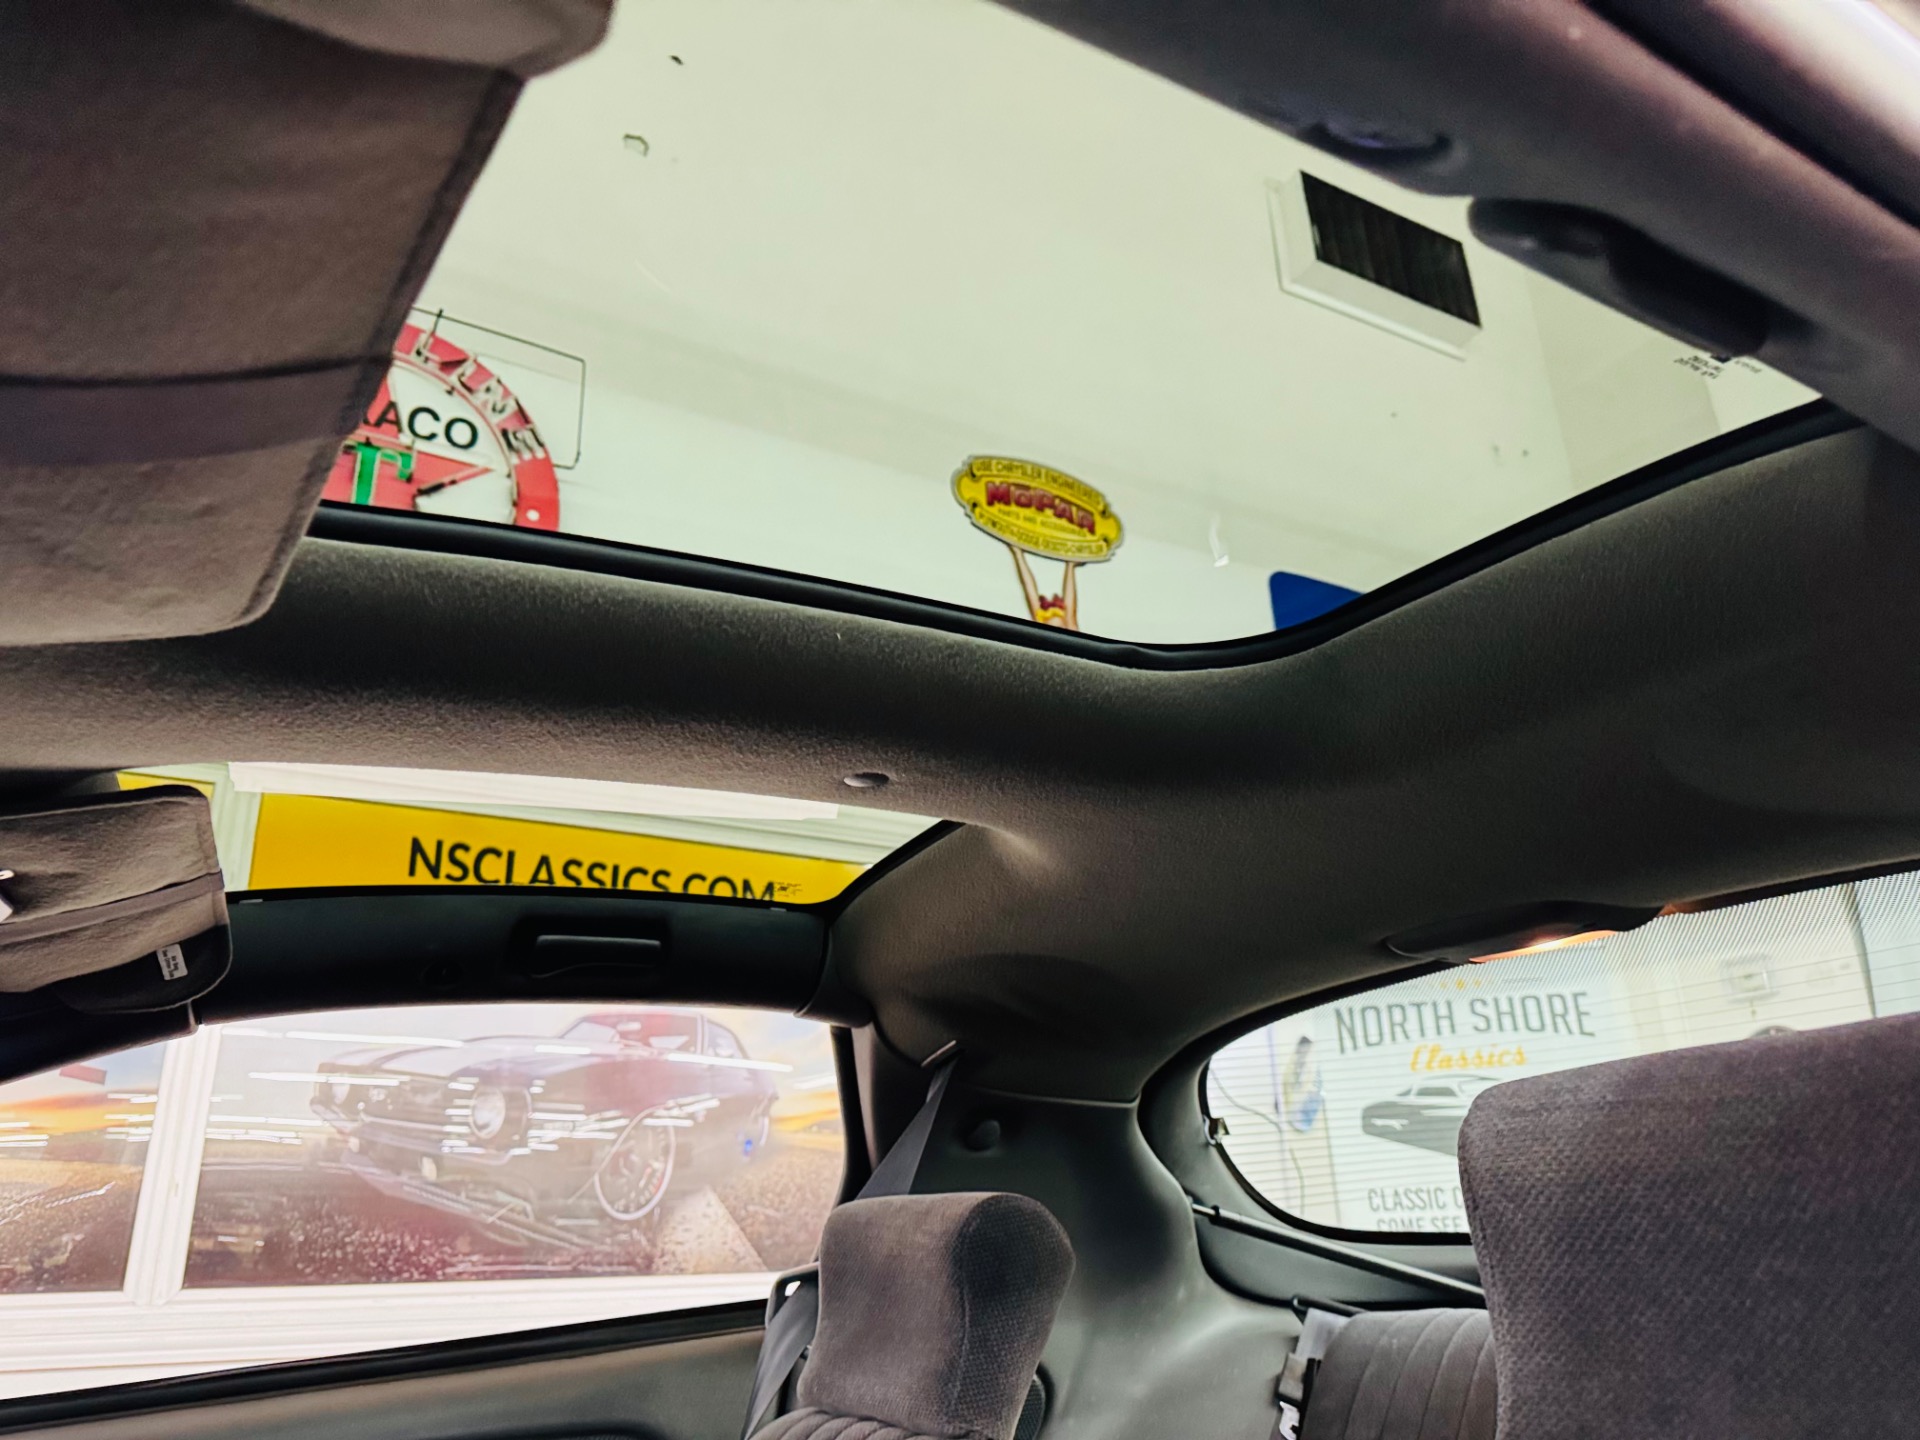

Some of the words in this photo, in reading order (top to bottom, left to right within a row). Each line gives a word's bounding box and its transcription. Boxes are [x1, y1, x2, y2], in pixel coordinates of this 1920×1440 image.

[363, 401, 479, 450] ACO
[985, 480, 1096, 536] MOPAR
[1334, 999, 1456, 1054] NORTH
[1470, 992, 1595, 1037] SHORE
[1410, 1043, 1527, 1072] Classics
[1368, 1186, 1447, 1212] CLASSIC
